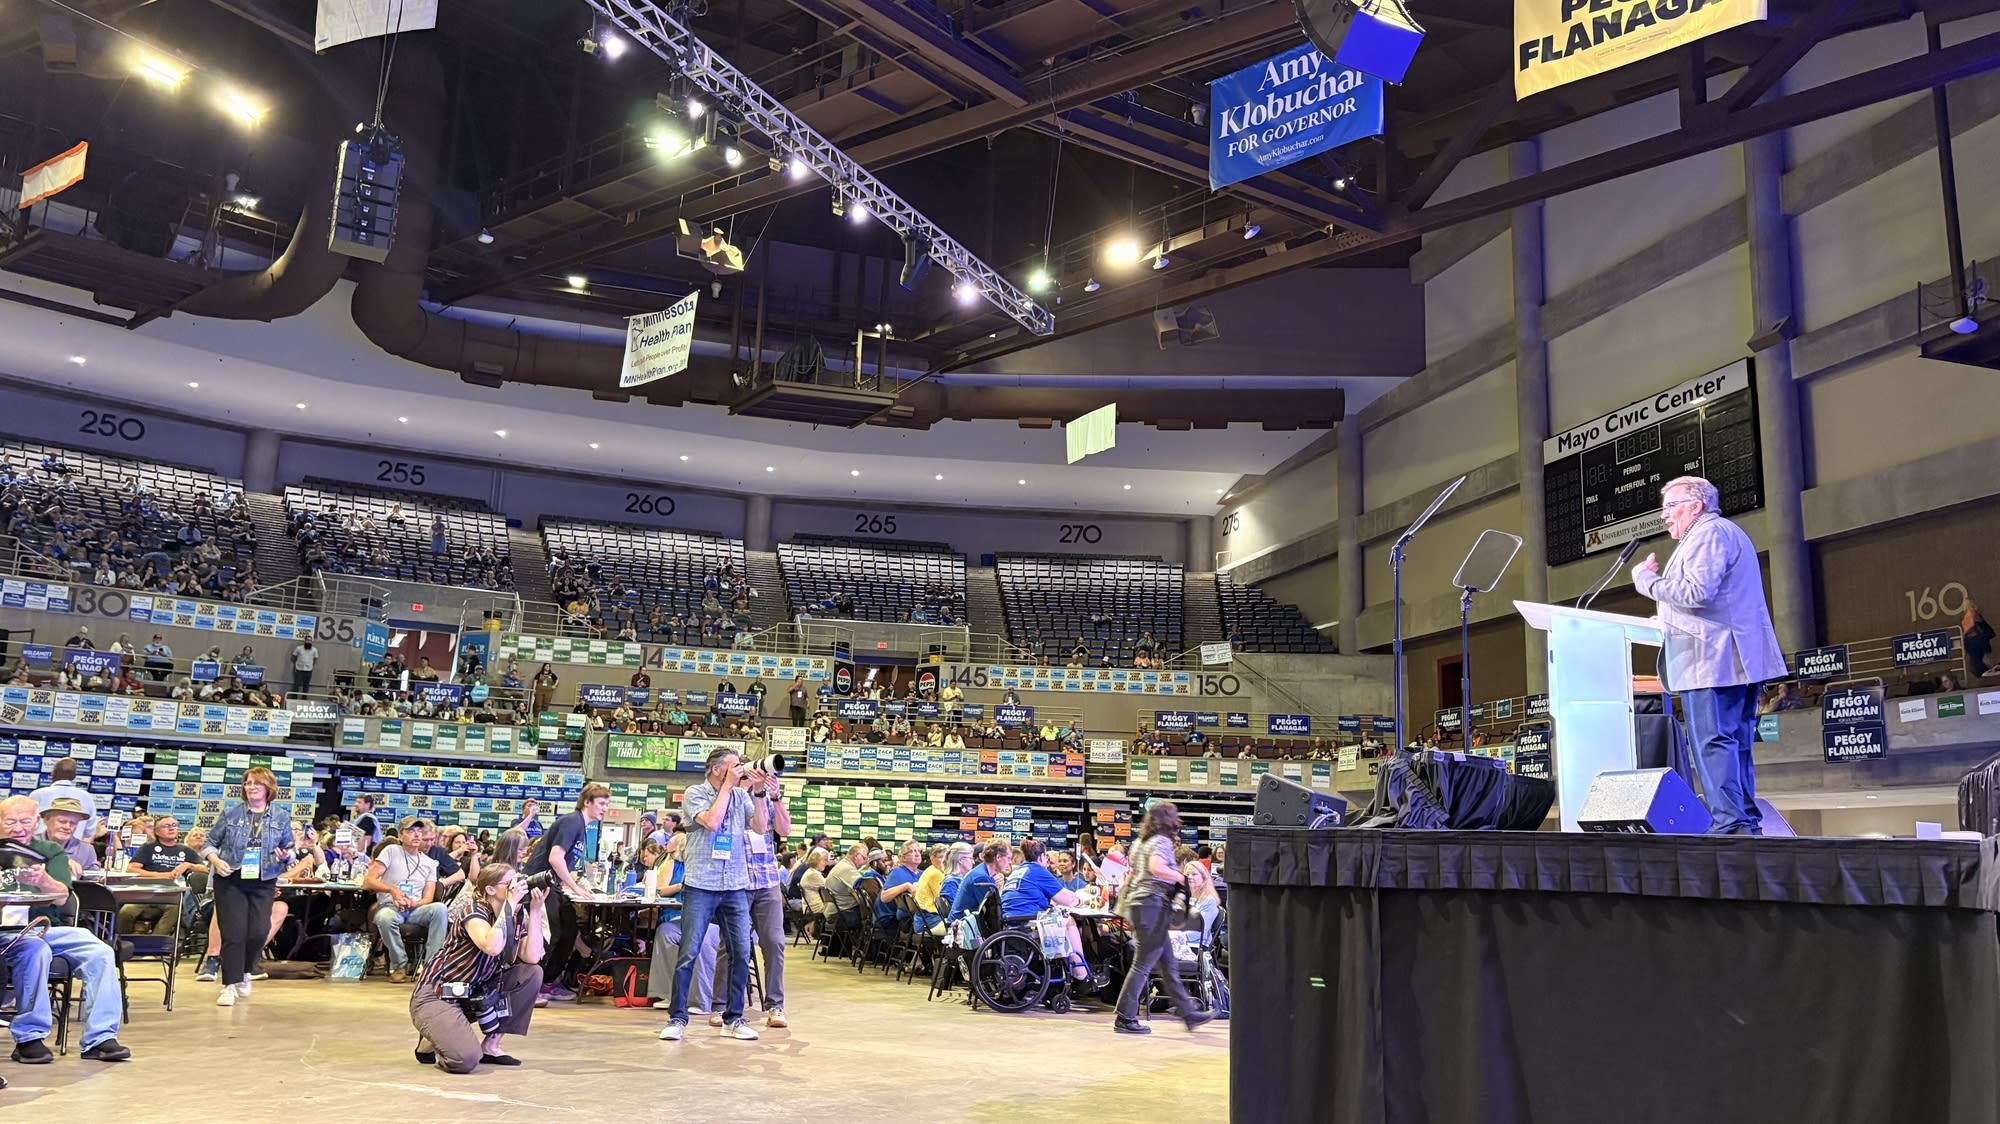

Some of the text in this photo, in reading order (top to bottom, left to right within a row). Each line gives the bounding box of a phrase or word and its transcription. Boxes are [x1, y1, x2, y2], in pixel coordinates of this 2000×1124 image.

[1257, 51, 1324, 92] Amy
[1227, 134, 1259, 158] FOR
[1261, 97, 1357, 144] GOVERNOR
[1257, 135, 1324, 163] AmyKlobuchar.com
[643, 300, 694, 329] Minnesota
[639, 322, 692, 348] Health Plan
[1557, 374, 1726, 453] Mayo Civic Center
[79, 410, 146, 441] 250
[1623, 463, 1642, 477] PERIOD
[1684, 460, 1699, 472] FOULS
[377, 460, 426, 487] 255
[1614, 473, 1661, 495] PLAYER FOUL PTS
[625, 493, 676, 516] 260
[855, 513, 898, 535] 265
[1222, 511, 1240, 537] 275
[1059, 524, 1102, 544] 270
[70, 587, 128, 618] 130
[1905, 581, 1968, 623] 160
[1902, 637, 1938, 652] PEGGY
[73, 655, 111, 667] PEGGY
[643, 646, 663, 669] 14
[1804, 653, 1836, 666] PEGGY
[1896, 647, 1947, 662] FLANAGAN
[1799, 662, 1844, 675] FLANAGAN
[950, 665, 989, 688] 145
[423, 687, 454, 696] PEGGY
[1196, 674, 1241, 696] 150
[589, 688, 617, 697] PEGGY
[723, 697, 750, 705] PEGGY
[1832, 695, 1871, 709] PEGGY
[296, 705, 330, 714] PEGGY
[1001, 709, 1027, 717] PEGGY
[1825, 705, 1879, 719] FLANAGAN
[1441, 712, 1458, 722] PEGGY
[1271, 724, 1308, 732] FLANAGAN
[1520, 734, 1543, 745] PEGGY
[1834, 732, 1873, 746] PEGGY
[616, 748, 642, 758] THRILL
[1516, 743, 1548, 753] FLANAGAN
[1827, 743, 1881, 757] FLANAGAN
[1521, 763, 1544, 773] PEGGY
